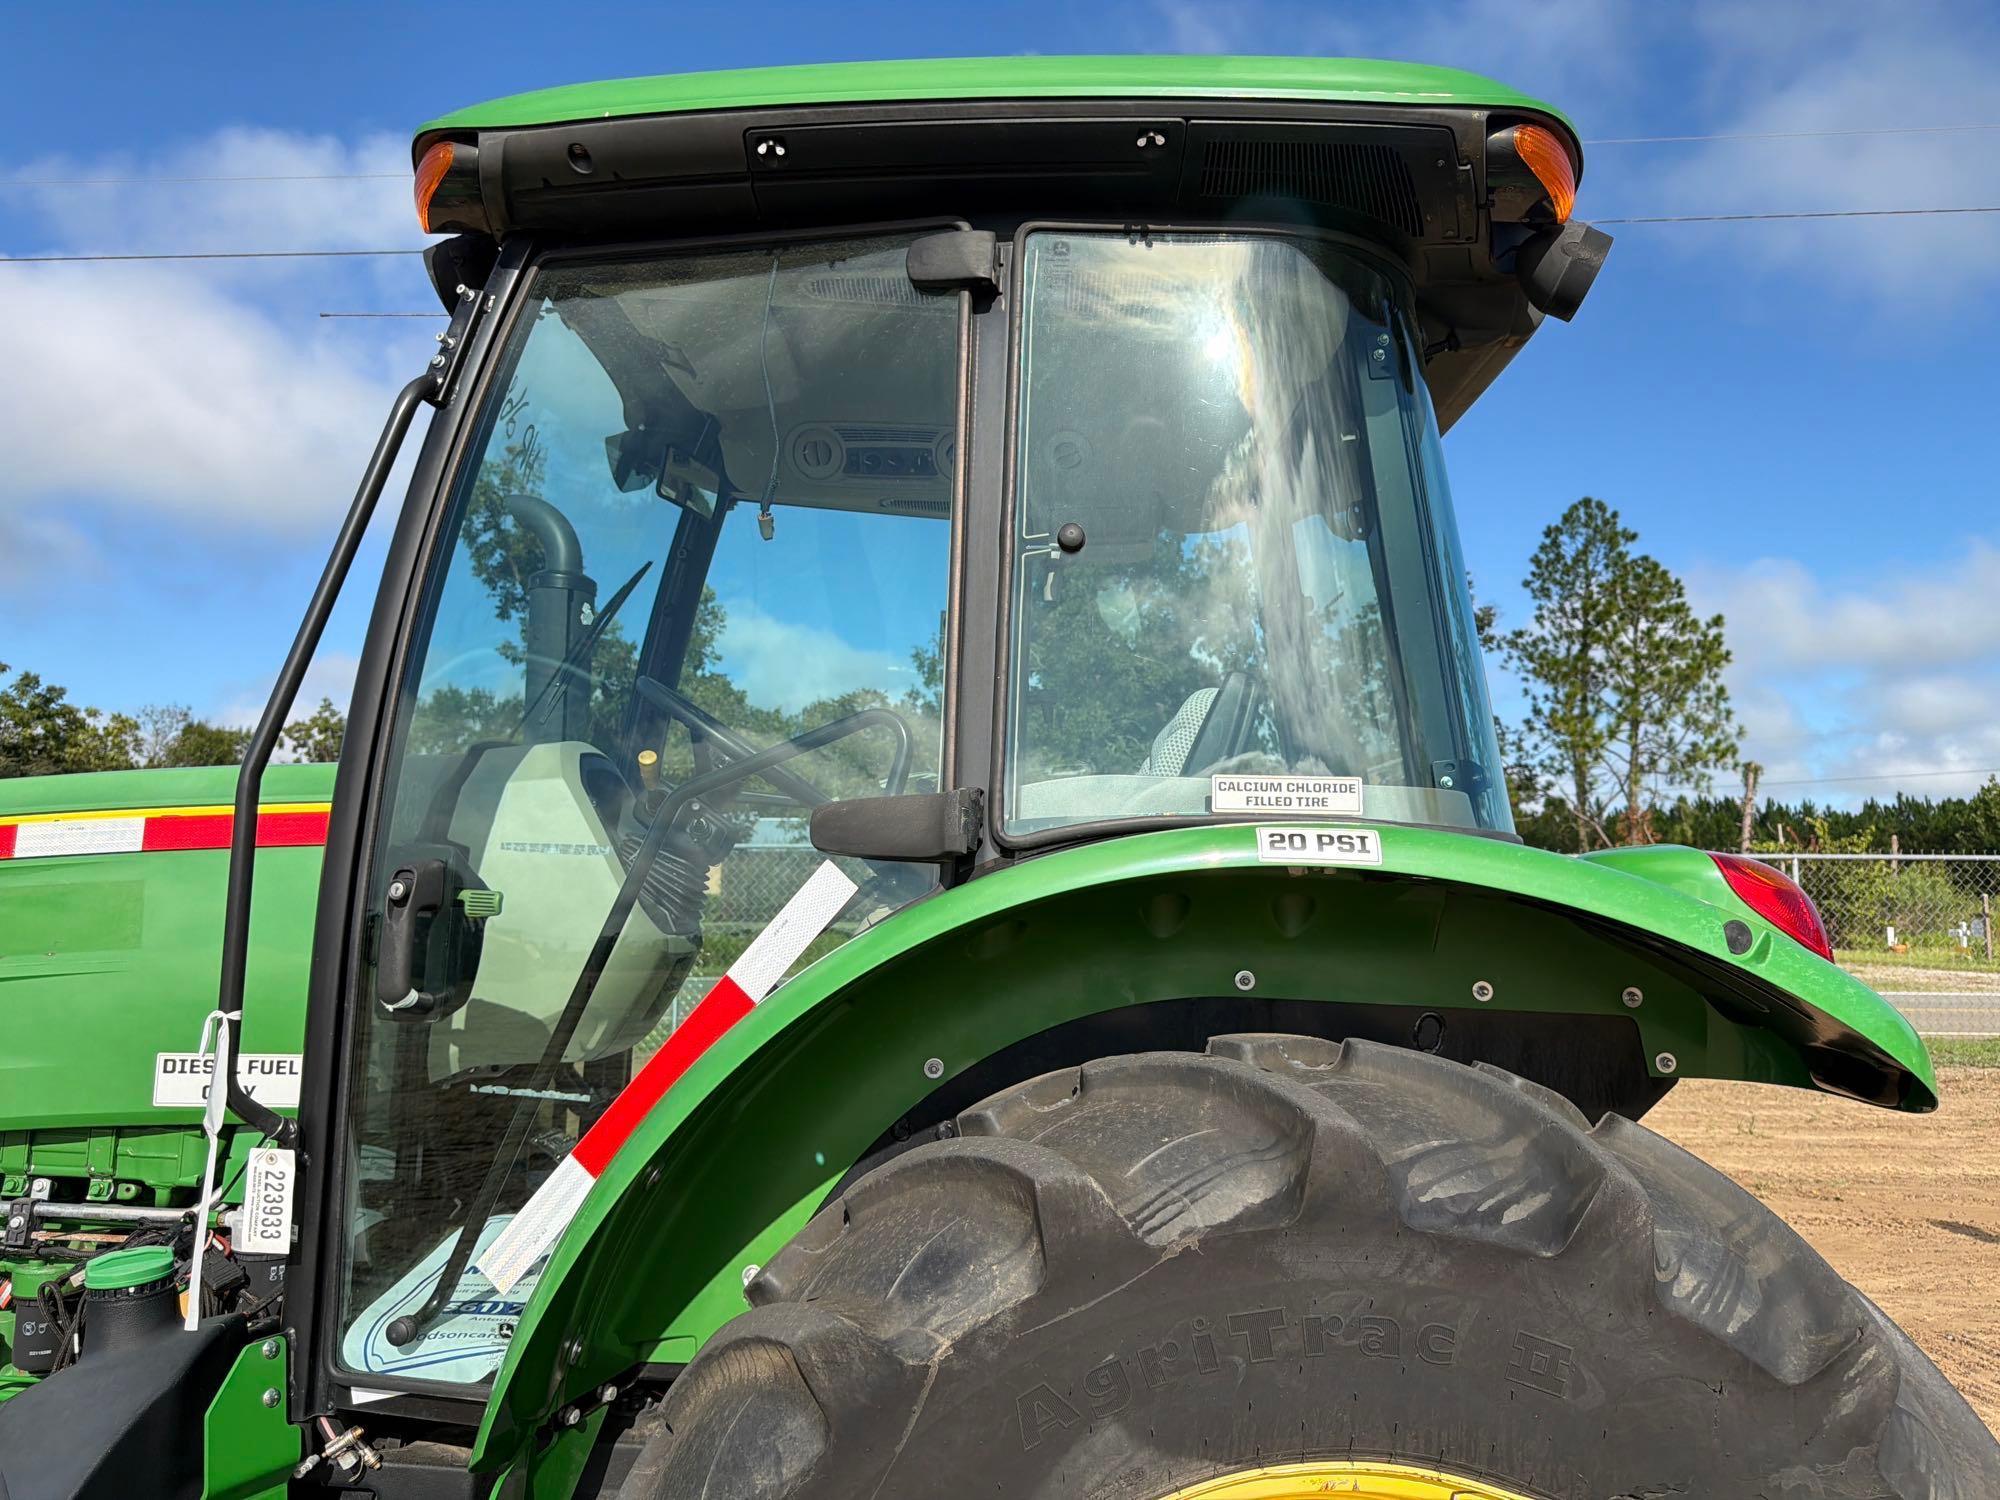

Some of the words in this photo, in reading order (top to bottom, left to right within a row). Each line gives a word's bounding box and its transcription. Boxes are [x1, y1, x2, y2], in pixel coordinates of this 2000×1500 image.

[1218, 781, 1282, 792] CALCIUM
[1286, 782, 1356, 794] CHLORIDE
[1246, 796, 1292, 807] FILLED
[1296, 796, 1329, 807] TIRE
[1268, 833, 1307, 851] 20
[1316, 833, 1371, 854] PSI
[163, 1058, 241, 1075] DIES
[248, 1060, 299, 1075] FUEL
[260, 1170, 286, 1239] 223933
[1015, 1306, 1457, 1451] AgriTrac
